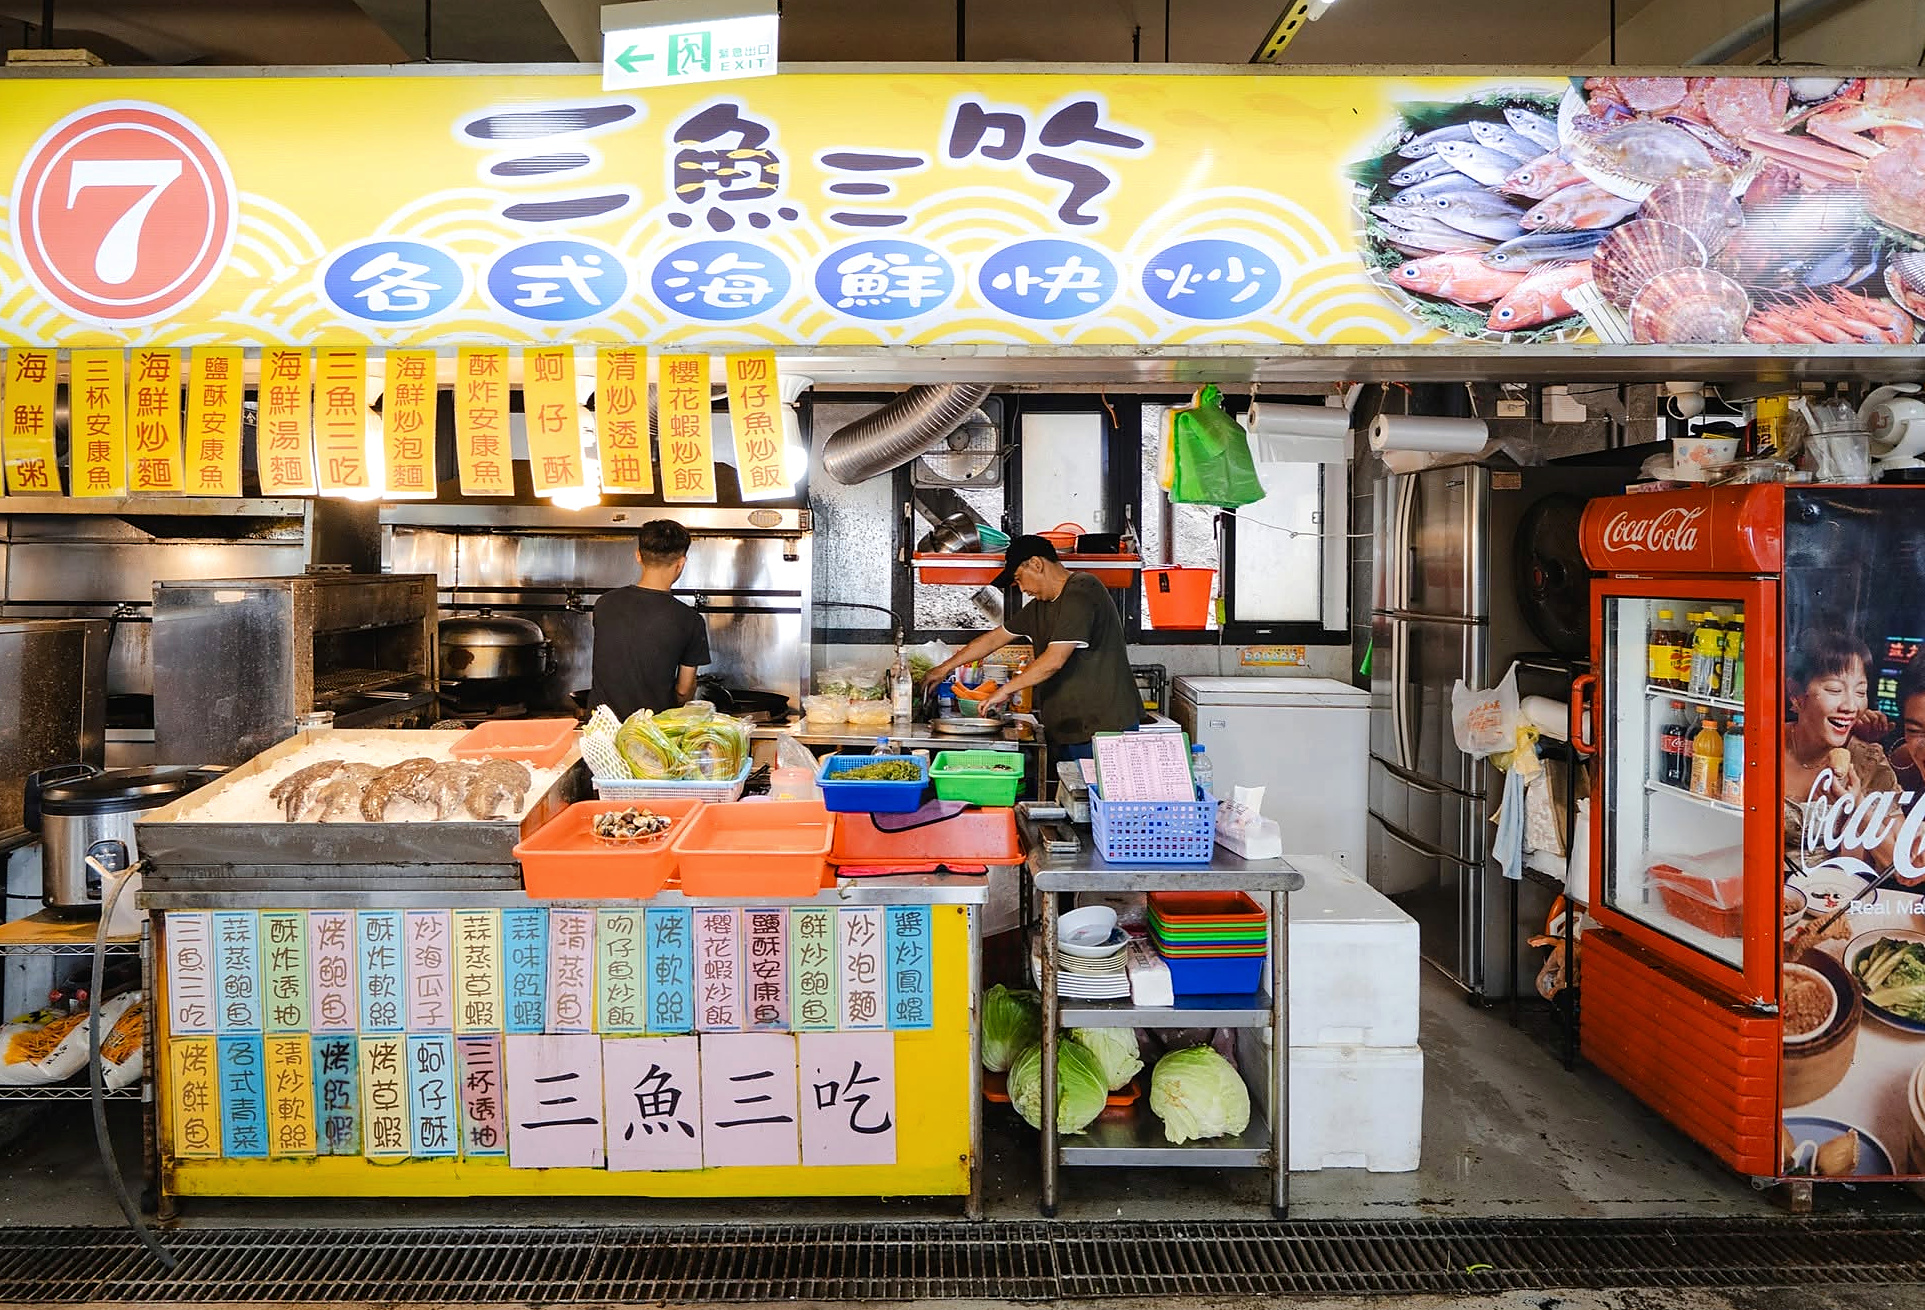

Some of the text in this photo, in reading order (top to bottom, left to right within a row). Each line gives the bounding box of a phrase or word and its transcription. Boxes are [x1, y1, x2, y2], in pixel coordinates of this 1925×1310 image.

[720, 58, 766, 71] EXIT
[66, 159, 183, 285] 7
[463, 101, 1144, 233] 三魚三吃
[350, 251, 1267, 312] 各式海鮮快炒
[13, 352, 48, 488] 海鮮粥
[85, 359, 112, 490] 三杯安康魚
[136, 351, 173, 488] 海鮮炒麵
[200, 357, 229, 490] 鹽酥安康魚
[268, 351, 302, 487] 海鮮湯麵
[326, 352, 363, 487] 三魚三吃
[393, 355, 427, 488] 海鮮炒泡麵
[467, 353, 503, 485] 酥炸安康魚
[534, 352, 575, 485] 蚵仔酥
[606, 351, 641, 484] 清炒透抽
[669, 360, 705, 491] 櫻花蝦炒飯
[737, 358, 782, 488] 吻仔魚炒飯
[1849, 900, 1890, 915] Real
[177, 919, 206, 1027] 三魚三吃
[223, 917, 252, 1027] 蒜蒸鮑魚
[270, 918, 300, 1026] 酥炸透抽
[318, 918, 347, 1025] 烤鮑魚
[366, 917, 397, 1026] 酥炸軟絲
[415, 916, 444, 1026] 炒海瓜子
[463, 916, 493, 1026] 蒜蒸草蝦
[512, 915, 542, 1026] 蒜味紅蝦
[557, 917, 587, 1025] 清蒸魚
[607, 915, 636, 1026] 吻仔魚炒飯
[655, 916, 685, 1025] 烤軟絲
[704, 914, 733, 1025] 櫻花蝦炒飯
[752, 914, 781, 1024] 鹽酥安康魚
[800, 914, 829, 1024] 鮮炒鮑魚
[847, 914, 876, 1022] 炒泡麵
[180, 1044, 210, 1150] 烤鮮魚
[227, 1042, 259, 1150] 各式青菜
[275, 1041, 308, 1149] 清炒軟絲
[321, 1041, 353, 1147] 烤紅蝦
[368, 1042, 402, 1148] 烤草蝦
[418, 1042, 448, 1148] 蚵仔酥
[466, 1042, 497, 1148] 三杯透抽
[520, 1060, 893, 1141] 三魚三吃
